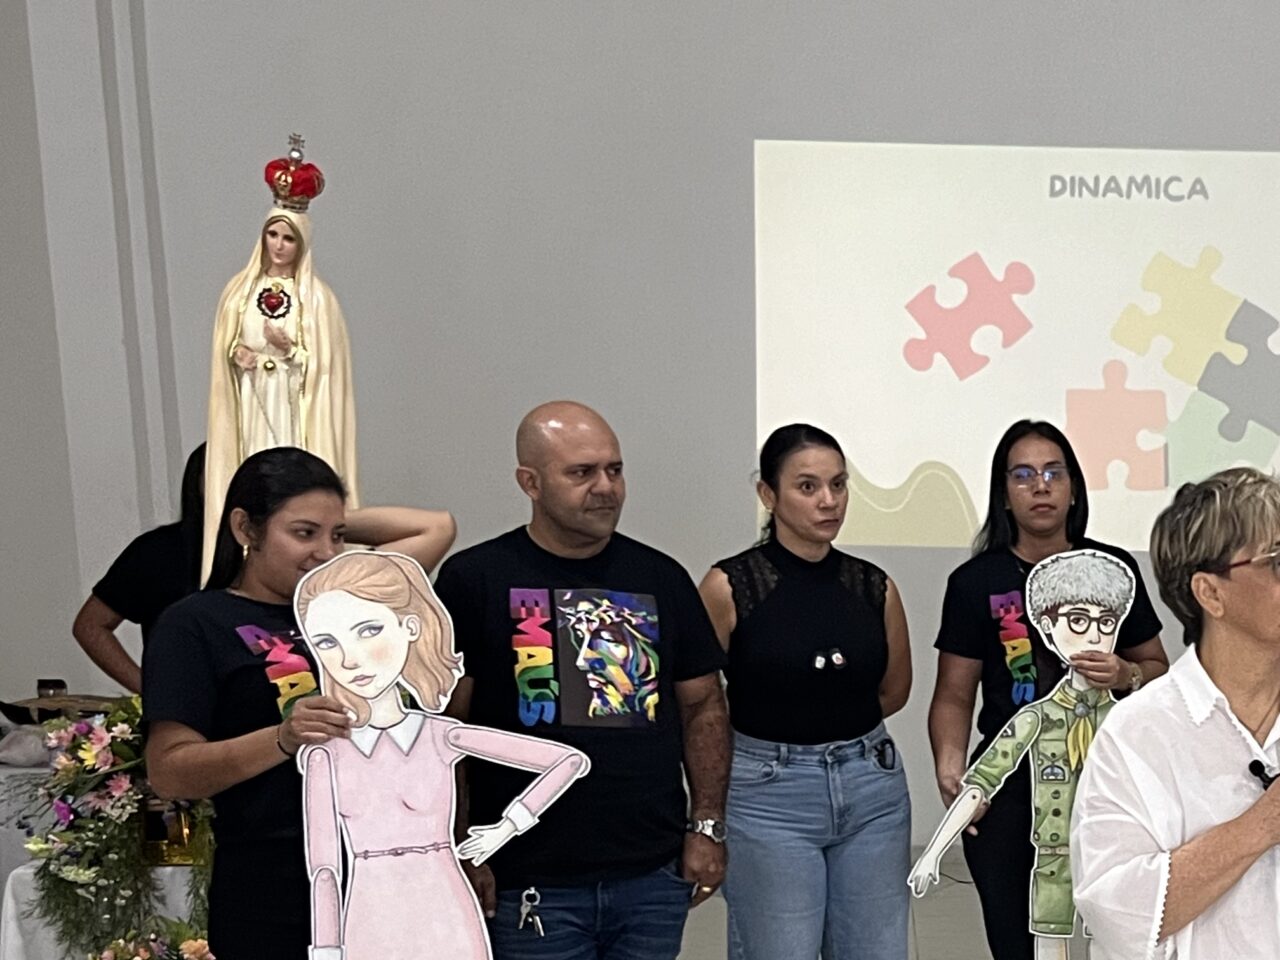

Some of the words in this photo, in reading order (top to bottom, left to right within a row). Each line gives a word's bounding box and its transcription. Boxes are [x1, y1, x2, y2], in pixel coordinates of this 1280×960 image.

[1049, 174, 1209, 202] DINAMICA
[510, 588, 559, 726] EMAUS
[989, 591, 1037, 705] EMAUS
